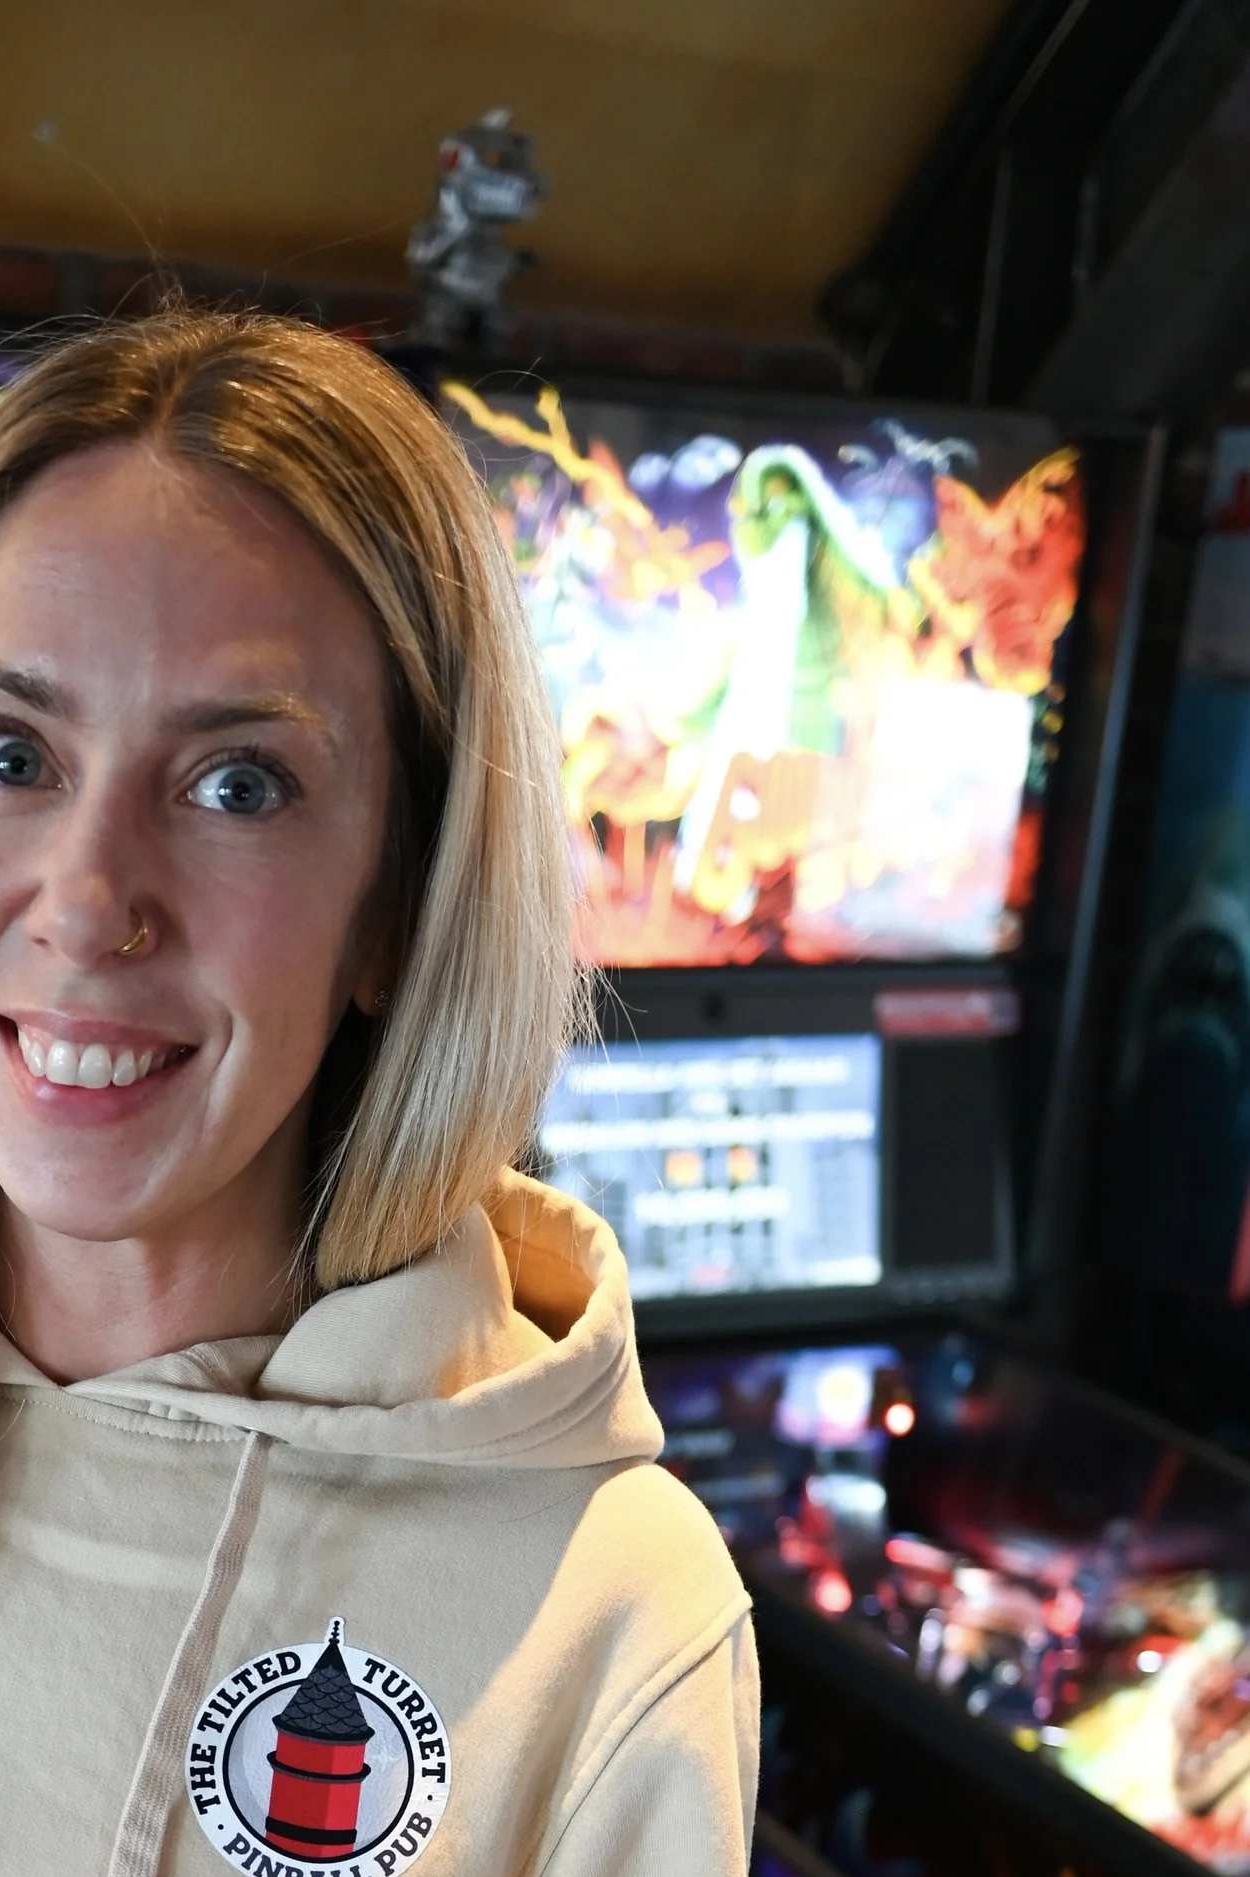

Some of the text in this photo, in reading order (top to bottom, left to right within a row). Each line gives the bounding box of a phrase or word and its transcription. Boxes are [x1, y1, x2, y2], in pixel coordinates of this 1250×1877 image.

[190, 1651, 446, 1815] THE TILTED TURRET
[374, 1812, 433, 1876] PUB
